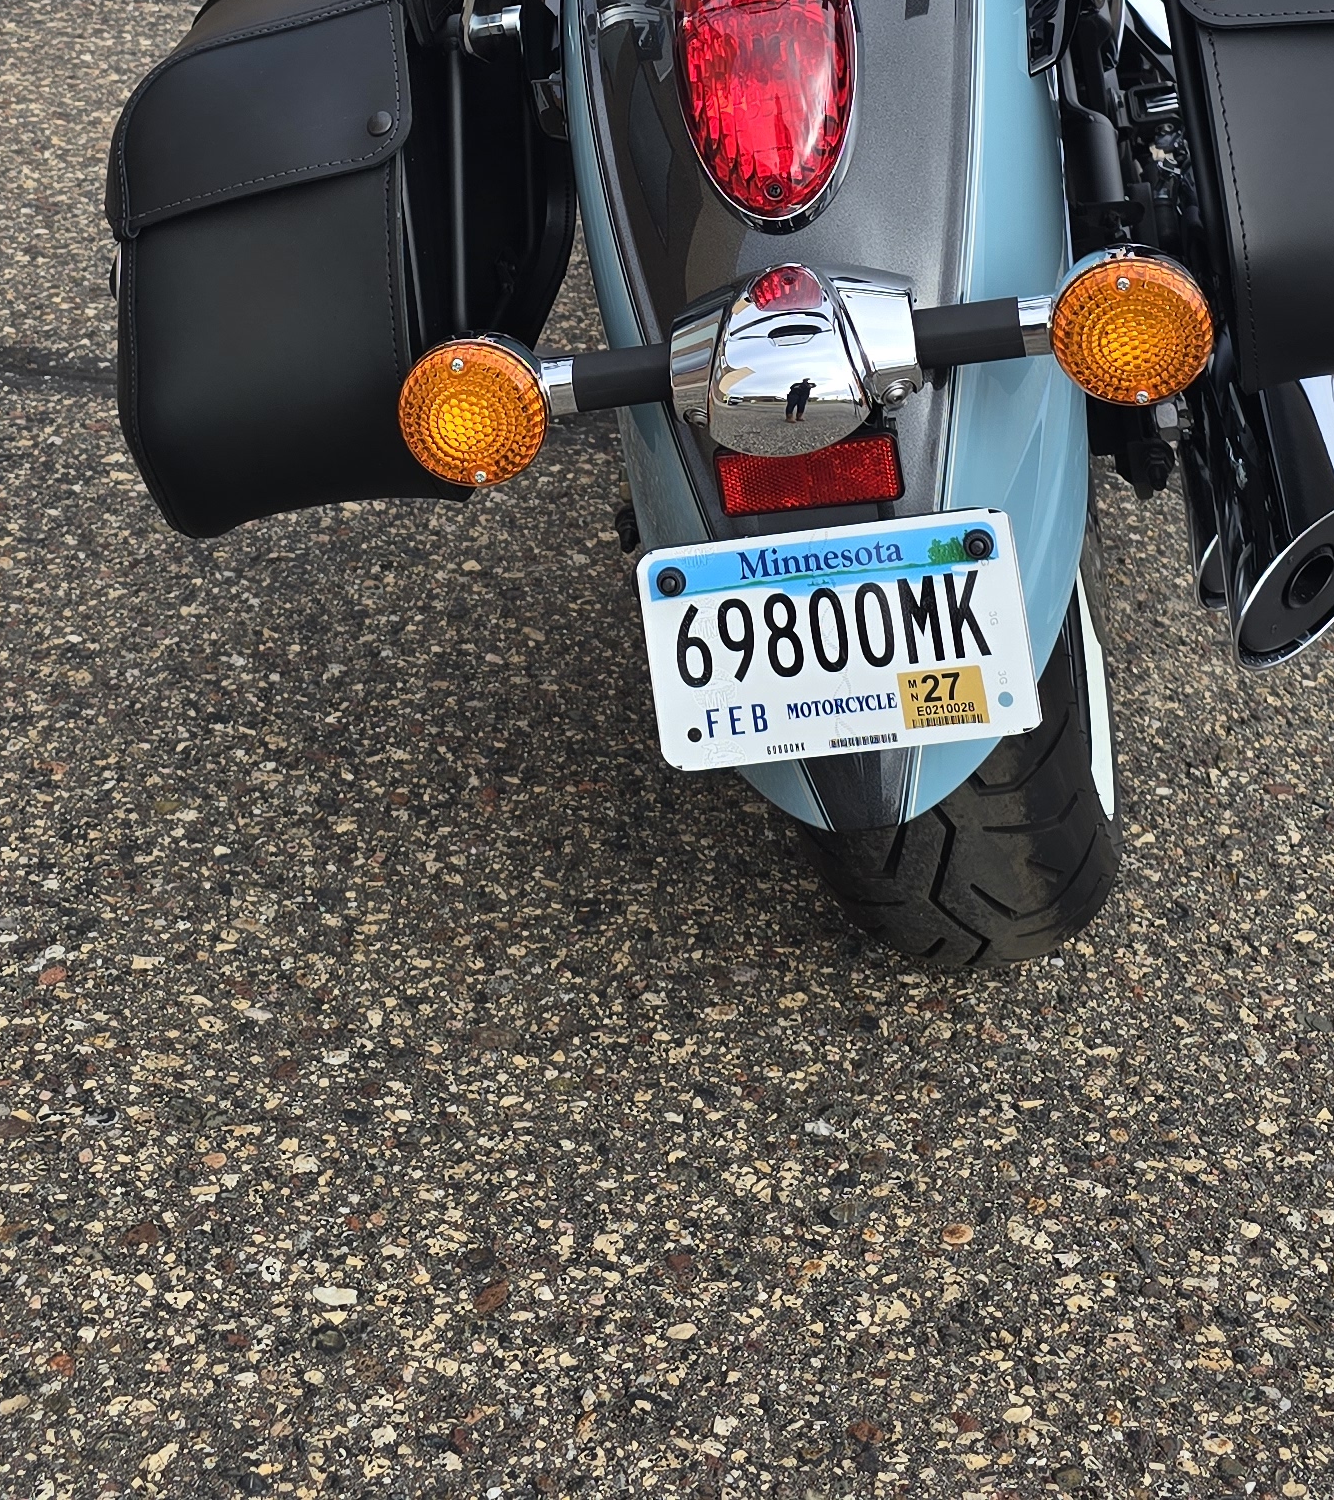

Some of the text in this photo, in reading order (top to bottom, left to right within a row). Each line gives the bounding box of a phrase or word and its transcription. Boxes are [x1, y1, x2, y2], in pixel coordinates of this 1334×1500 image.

[736, 540, 904, 581] Minnesota
[676, 570, 992, 688] 69800MK
[921, 671, 960, 703] 27
[705, 703, 769, 739] FEB
[786, 692, 898, 720] MOTORCYCLE
[916, 701, 975, 717] E0210028
